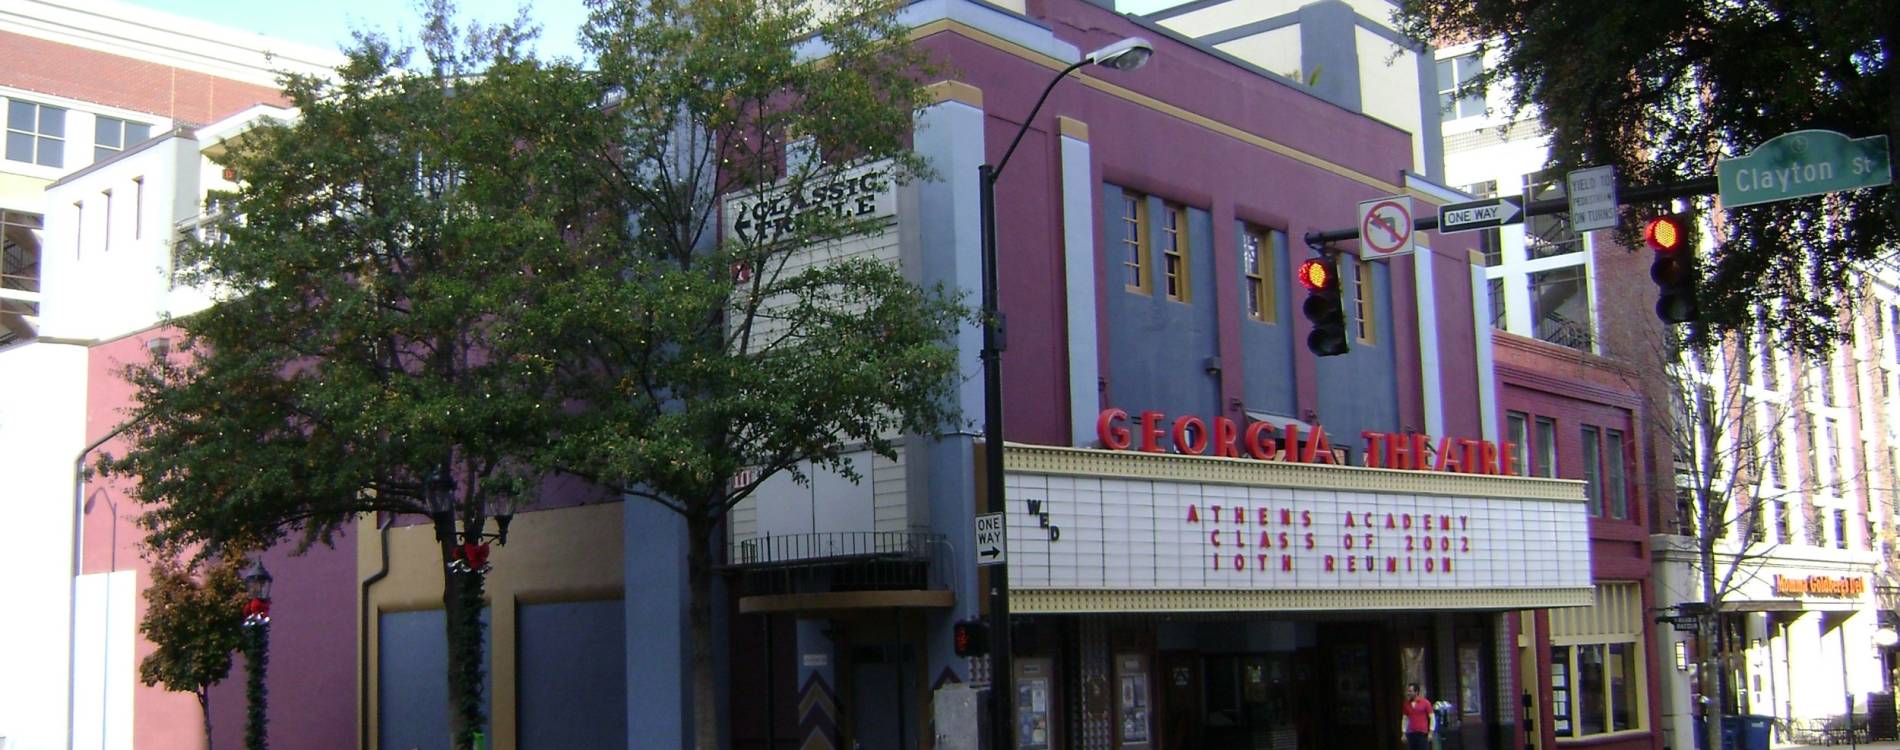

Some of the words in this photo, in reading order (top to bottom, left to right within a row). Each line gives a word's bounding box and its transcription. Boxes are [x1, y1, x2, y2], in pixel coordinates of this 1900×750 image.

[1573, 177, 1596, 192] YIELD
[1600, 174, 1611, 186] TO
[1736, 161, 1833, 193] Clayton
[1852, 156, 1872, 175] St
[752, 173, 878, 221] CLASSIC
[1448, 210, 1471, 224] ONE
[1474, 206, 1498, 220] WAY
[1588, 208, 1614, 222] TURNS
[1097, 408, 1335, 464] GEORGIA
[1361, 430, 1519, 475] THEATRE
[978, 517, 1000, 531] ONE
[1027, 499, 1060, 541] WED
[1187, 504, 1312, 527] ATHENS
[1345, 511, 1467, 531] ACADEMY
[978, 532, 1001, 544] WAY
[1211, 529, 1315, 550] CLASS
[1344, 533, 1373, 550] OF
[1405, 535, 1469, 552] 2002
[1324, 555, 1451, 573] REUNION
